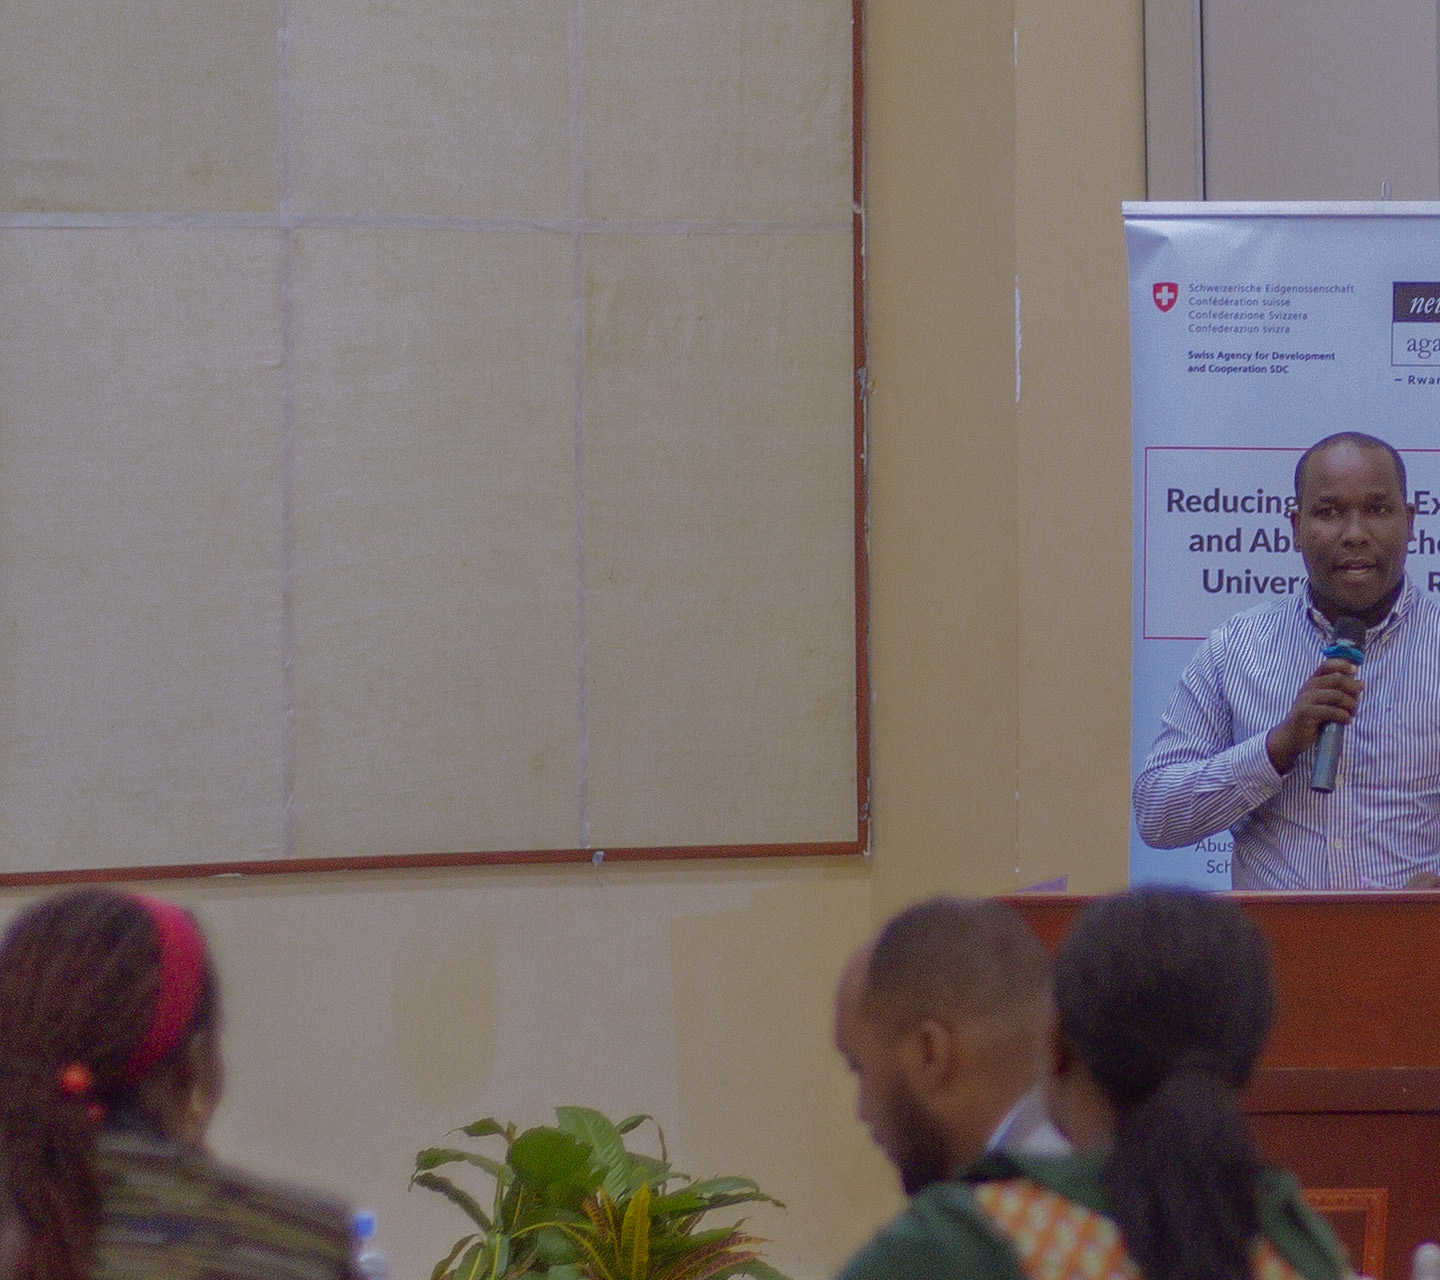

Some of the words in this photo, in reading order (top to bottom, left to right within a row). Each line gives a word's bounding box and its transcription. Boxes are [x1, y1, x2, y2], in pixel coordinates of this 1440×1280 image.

[1188, 283, 1261, 294] Schweizerische
[1265, 283, 1355, 295] Eidgenossenschaft
[1262, 297, 1291, 307] suisse
[1188, 309, 1265, 320] Confederazione
[1268, 310, 1308, 320] Svizzera
[1188, 323, 1260, 334] Confederaziun
[1262, 324, 1291, 334] svizra
[1188, 350, 1215, 360] Swiss
[1217, 351, 1252, 362] Agency
[1255, 351, 1269, 361] for
[1271, 351, 1336, 362] Development
[1187, 364, 1206, 373] and
[1208, 364, 1268, 375] Cooperation
[1269, 365, 1290, 374] SDC
[1166, 488, 1299, 519] Reducing
[1189, 527, 1242, 553] and
[1249, 528, 1301, 553] Ab
[1203, 568, 1307, 595] Univer
